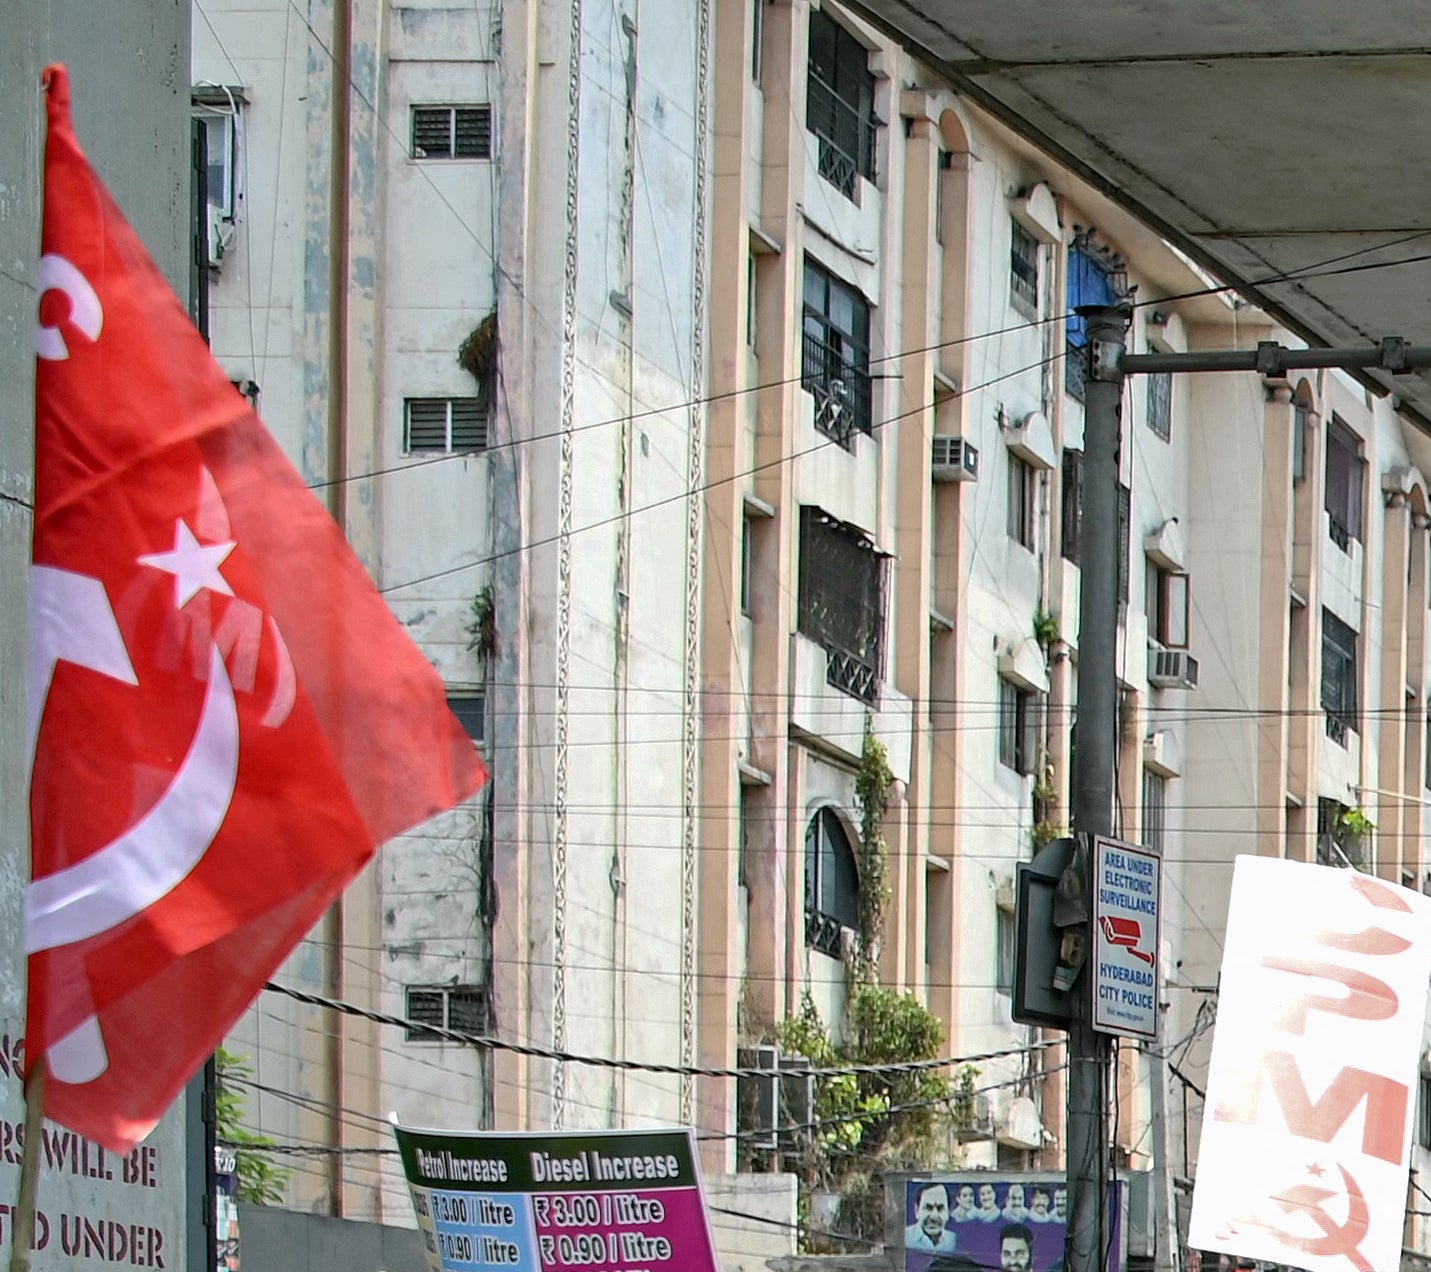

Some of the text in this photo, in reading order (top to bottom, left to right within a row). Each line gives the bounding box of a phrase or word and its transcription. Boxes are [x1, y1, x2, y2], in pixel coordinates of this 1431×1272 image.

[1105, 852, 1153, 876] AREA UNDER
[1105, 870, 1152, 895] ELECTRONIC
[1100, 889, 1155, 915] SURVEILLANCE
[1100, 963, 1153, 987] HYDERABAD
[1100, 985, 1153, 1010] CITY POLICE
[41, 1127, 157, 1188] WILL BE
[417, 1148, 508, 1182] Petrol Increase
[530, 1150, 680, 1182] Diesel Increase
[551, 1198, 599, 1225] 3.00
[60, 1213, 166, 1269] UNDER
[559, 1238, 604, 1265] 0.90
